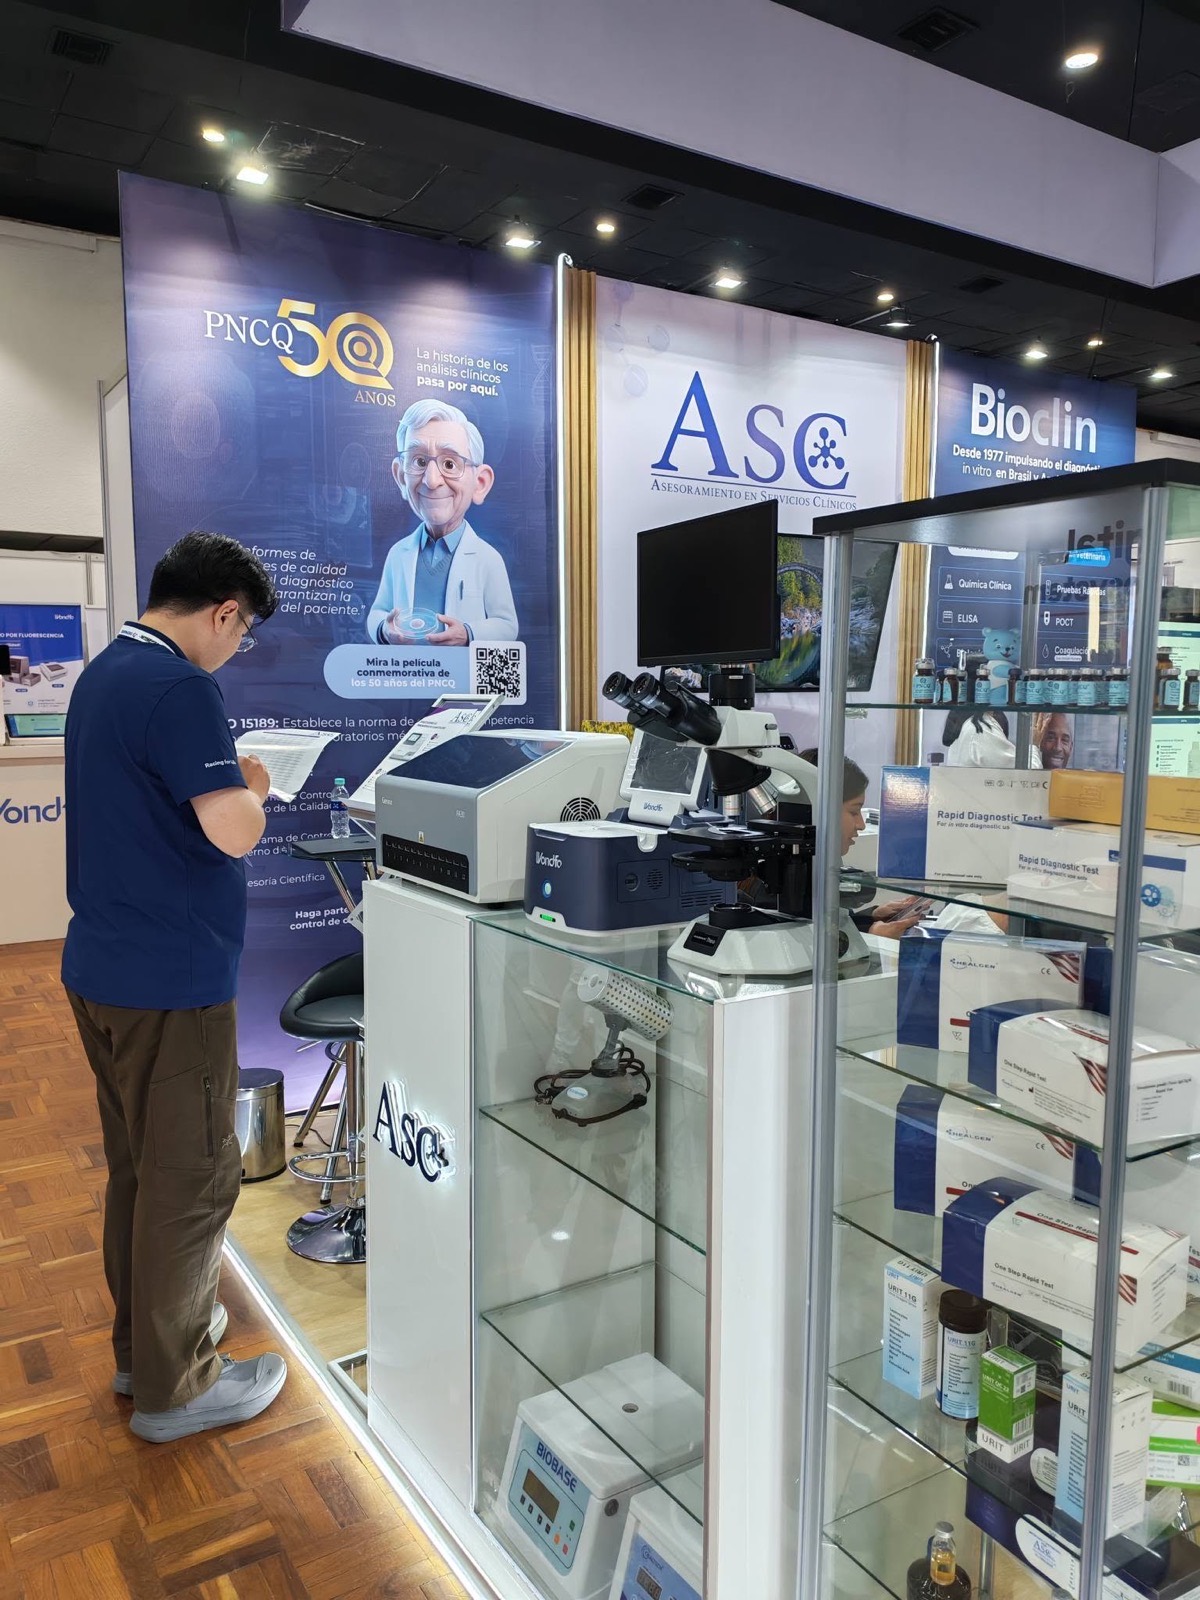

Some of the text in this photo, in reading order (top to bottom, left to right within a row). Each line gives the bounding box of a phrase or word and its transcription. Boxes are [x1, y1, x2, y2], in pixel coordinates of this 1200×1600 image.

[203, 310, 294, 354] PNCQ
[416, 347, 509, 372] La historia de los
[416, 363, 501, 384] análisis clínicos
[417, 376, 499, 396] pasa por aquí.
[971, 382, 1097, 453] Bioclin
[953, 444, 981, 459] Desde
[983, 449, 1003, 461] 1977
[1005, 451, 1053, 470] impulsando
[1055, 459, 1063, 470] el
[962, 462, 971, 474] in
[972, 464, 992, 477] vitro
[995, 468, 1006, 478] en
[1008, 469, 1032, 481] Brasil
[651, 479, 742, 500] ASESORAMIENTO
[744, 491, 757, 501] EN
[813, 496, 857, 510] CLÍNICOS
[300, 549, 317, 560] de
[261, 562, 348, 576] es de calidad
[279, 574, 354, 589] diagnóstico
[959, 579, 1012, 591] Química Clínica
[340, 591, 351, 602] la
[1057, 585, 1081, 595] Pruebas
[280, 602, 301, 613] del
[957, 614, 978, 623] ELISA
[1055, 618, 1073, 626] POCT
[1054, 645, 1090, 657] Coagulació
[366, 658, 441, 668] Mira la película
[357, 668, 450, 678] conmemorativa de
[351, 679, 456, 689] los 50 años del PNCQ
[240, 718, 279, 729] 15189:
[282, 716, 342, 728] Establece
[345, 717, 355, 727] la
[358, 719, 397, 727] norma
[400, 717, 414, 727] de
[333, 731, 385, 741] oratorios
[273, 804, 287, 813] de
[289, 803, 297, 812] la
[937, 810, 965, 820] Rapid
[967, 811, 1019, 822] Diagnostic
[285, 833, 298, 842] de
[1018, 854, 1099, 875] Rapid Diagnostic Test
[279, 872, 325, 885] Científica
[295, 906, 349, 920] Haga parte
[289, 917, 340, 931] control de
[1003, 1058, 1013, 1067] One
[1013, 1062, 1023, 1072] Step
[1023, 1066, 1036, 1077] Rapid
[994, 1262, 1054, 1289] One Step Rapid Test
[887, 1282, 917, 1303] URIT 11G
[1068, 1400, 1086, 1417] URIT
[981, 1433, 1004, 1452] URIT
[1013, 1439, 1030, 1455] URIT
[536, 1441, 578, 1494] BIOBASE
